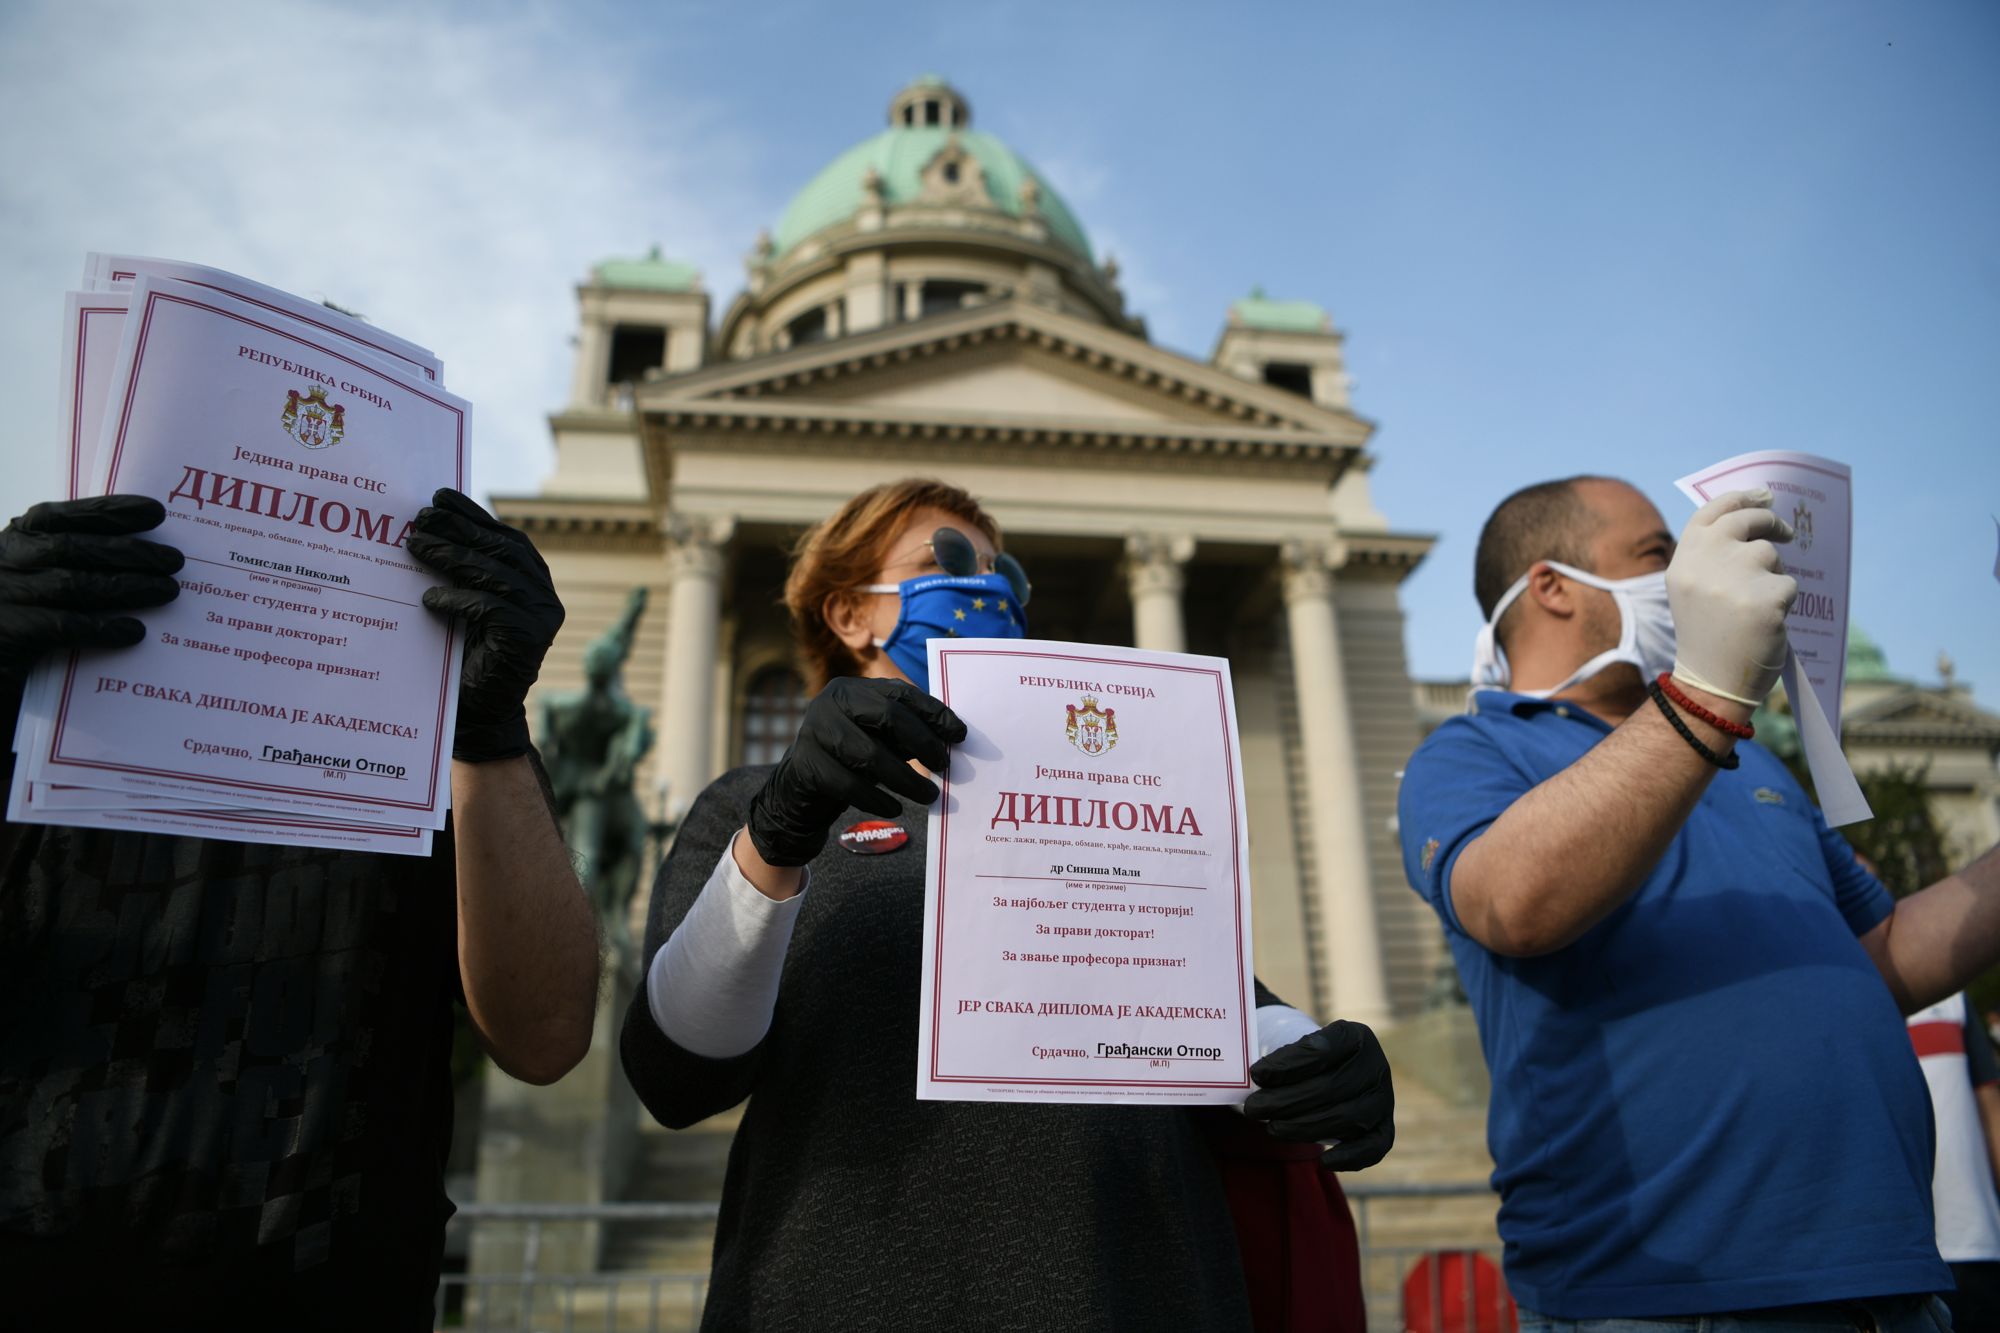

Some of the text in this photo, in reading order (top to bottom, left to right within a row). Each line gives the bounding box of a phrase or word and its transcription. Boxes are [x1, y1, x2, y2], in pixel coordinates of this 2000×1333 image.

[237, 345, 392, 411] РЕПУБЛИКА СРБИЈА
[232, 445, 387, 495] Једина права СНС
[165, 507, 192, 521] дсек:
[192, 516, 223, 529] лажи,
[224, 523, 266, 538] превара,
[268, 532, 305, 547] обмане,
[307, 541, 336, 554] крађе,
[337, 548, 373, 563] насиља,
[228, 551, 350, 585] Томислав Николић
[248, 572, 271, 584] (име
[280, 580, 322, 595] презиме)
[180, 578, 399, 632] најбољег студента у историји!
[1790, 591, 1835, 622] ЛОМА
[205, 610, 348, 647] За прави докторат!
[160, 631, 380, 681] За звање професора признат!
[1019, 675, 1156, 700] РЕПУБЛИКА СРБИЈА
[95, 676, 418, 740] ЈЕР СВАКА ДИПЛОМА ЈЕ АКАДЕМСКА!
[183, 738, 406, 776] Срдачно, Грађански Отпор
[323, 769, 347, 782] (М.П)
[1035, 764, 1162, 787] Једина права СНС
[991, 791, 1203, 837] ДИПЛОМА
[985, 834, 1212, 857] Одсек: лажи, превара, обмане, крађе, насиља, криминала...
[1050, 864, 1141, 878] др Синиша Мали
[1065, 881, 1084, 890] (име
[1091, 883, 1127, 893] презиме)
[992, 896, 1194, 918] За најбољег студента у историји!
[1035, 924, 1155, 941] За прави докторат!
[1002, 950, 1186, 969] За звање професора признат!
[957, 999, 1227, 1021] ЈЕР СВАКА ДИПЛОМА ЈЕ АКАДЕМСКА!
[1031, 1042, 1222, 1060] Срдачно, Грађански Отпор
[1149, 1059, 1170, 1069] (М.П)
